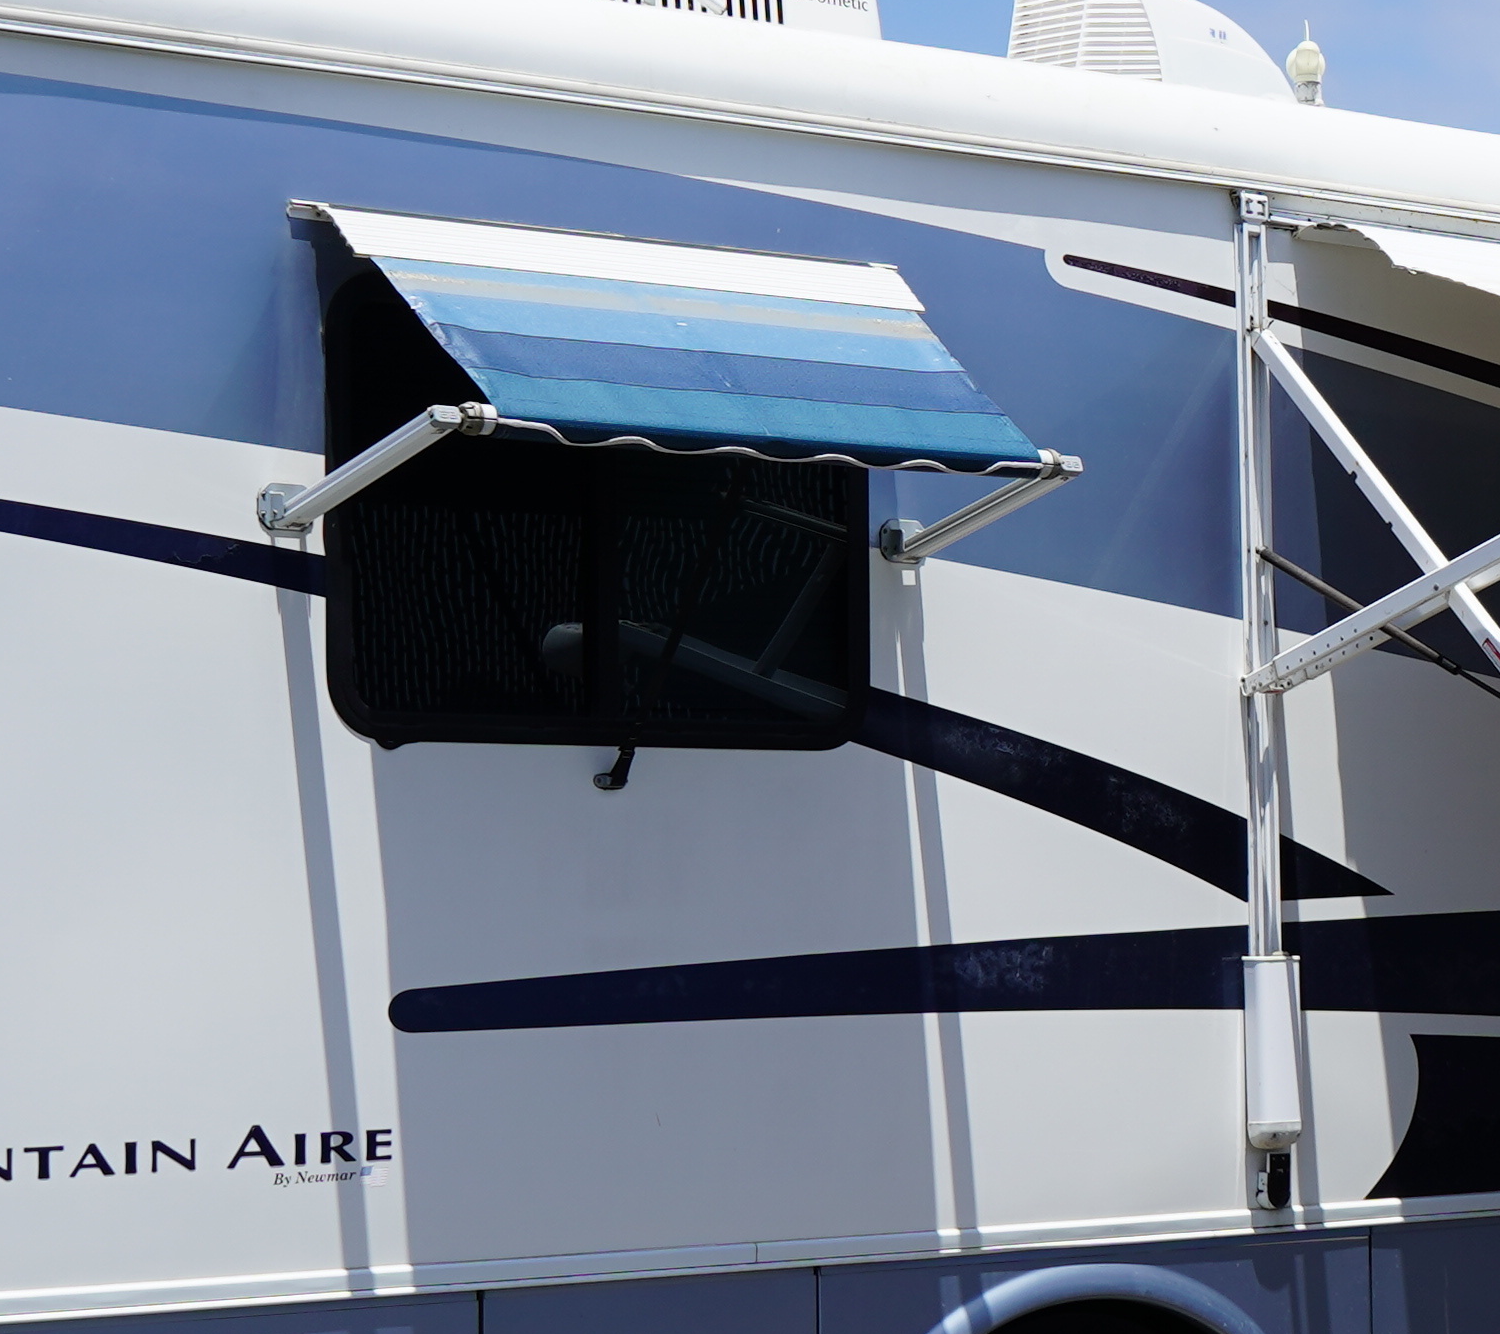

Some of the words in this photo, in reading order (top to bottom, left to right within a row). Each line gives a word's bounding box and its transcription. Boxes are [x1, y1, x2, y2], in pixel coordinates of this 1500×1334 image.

[228, 1125, 393, 1169] AIRE
[273, 1173, 292, 1187] By
[295, 1171, 357, 1184] Newmar
